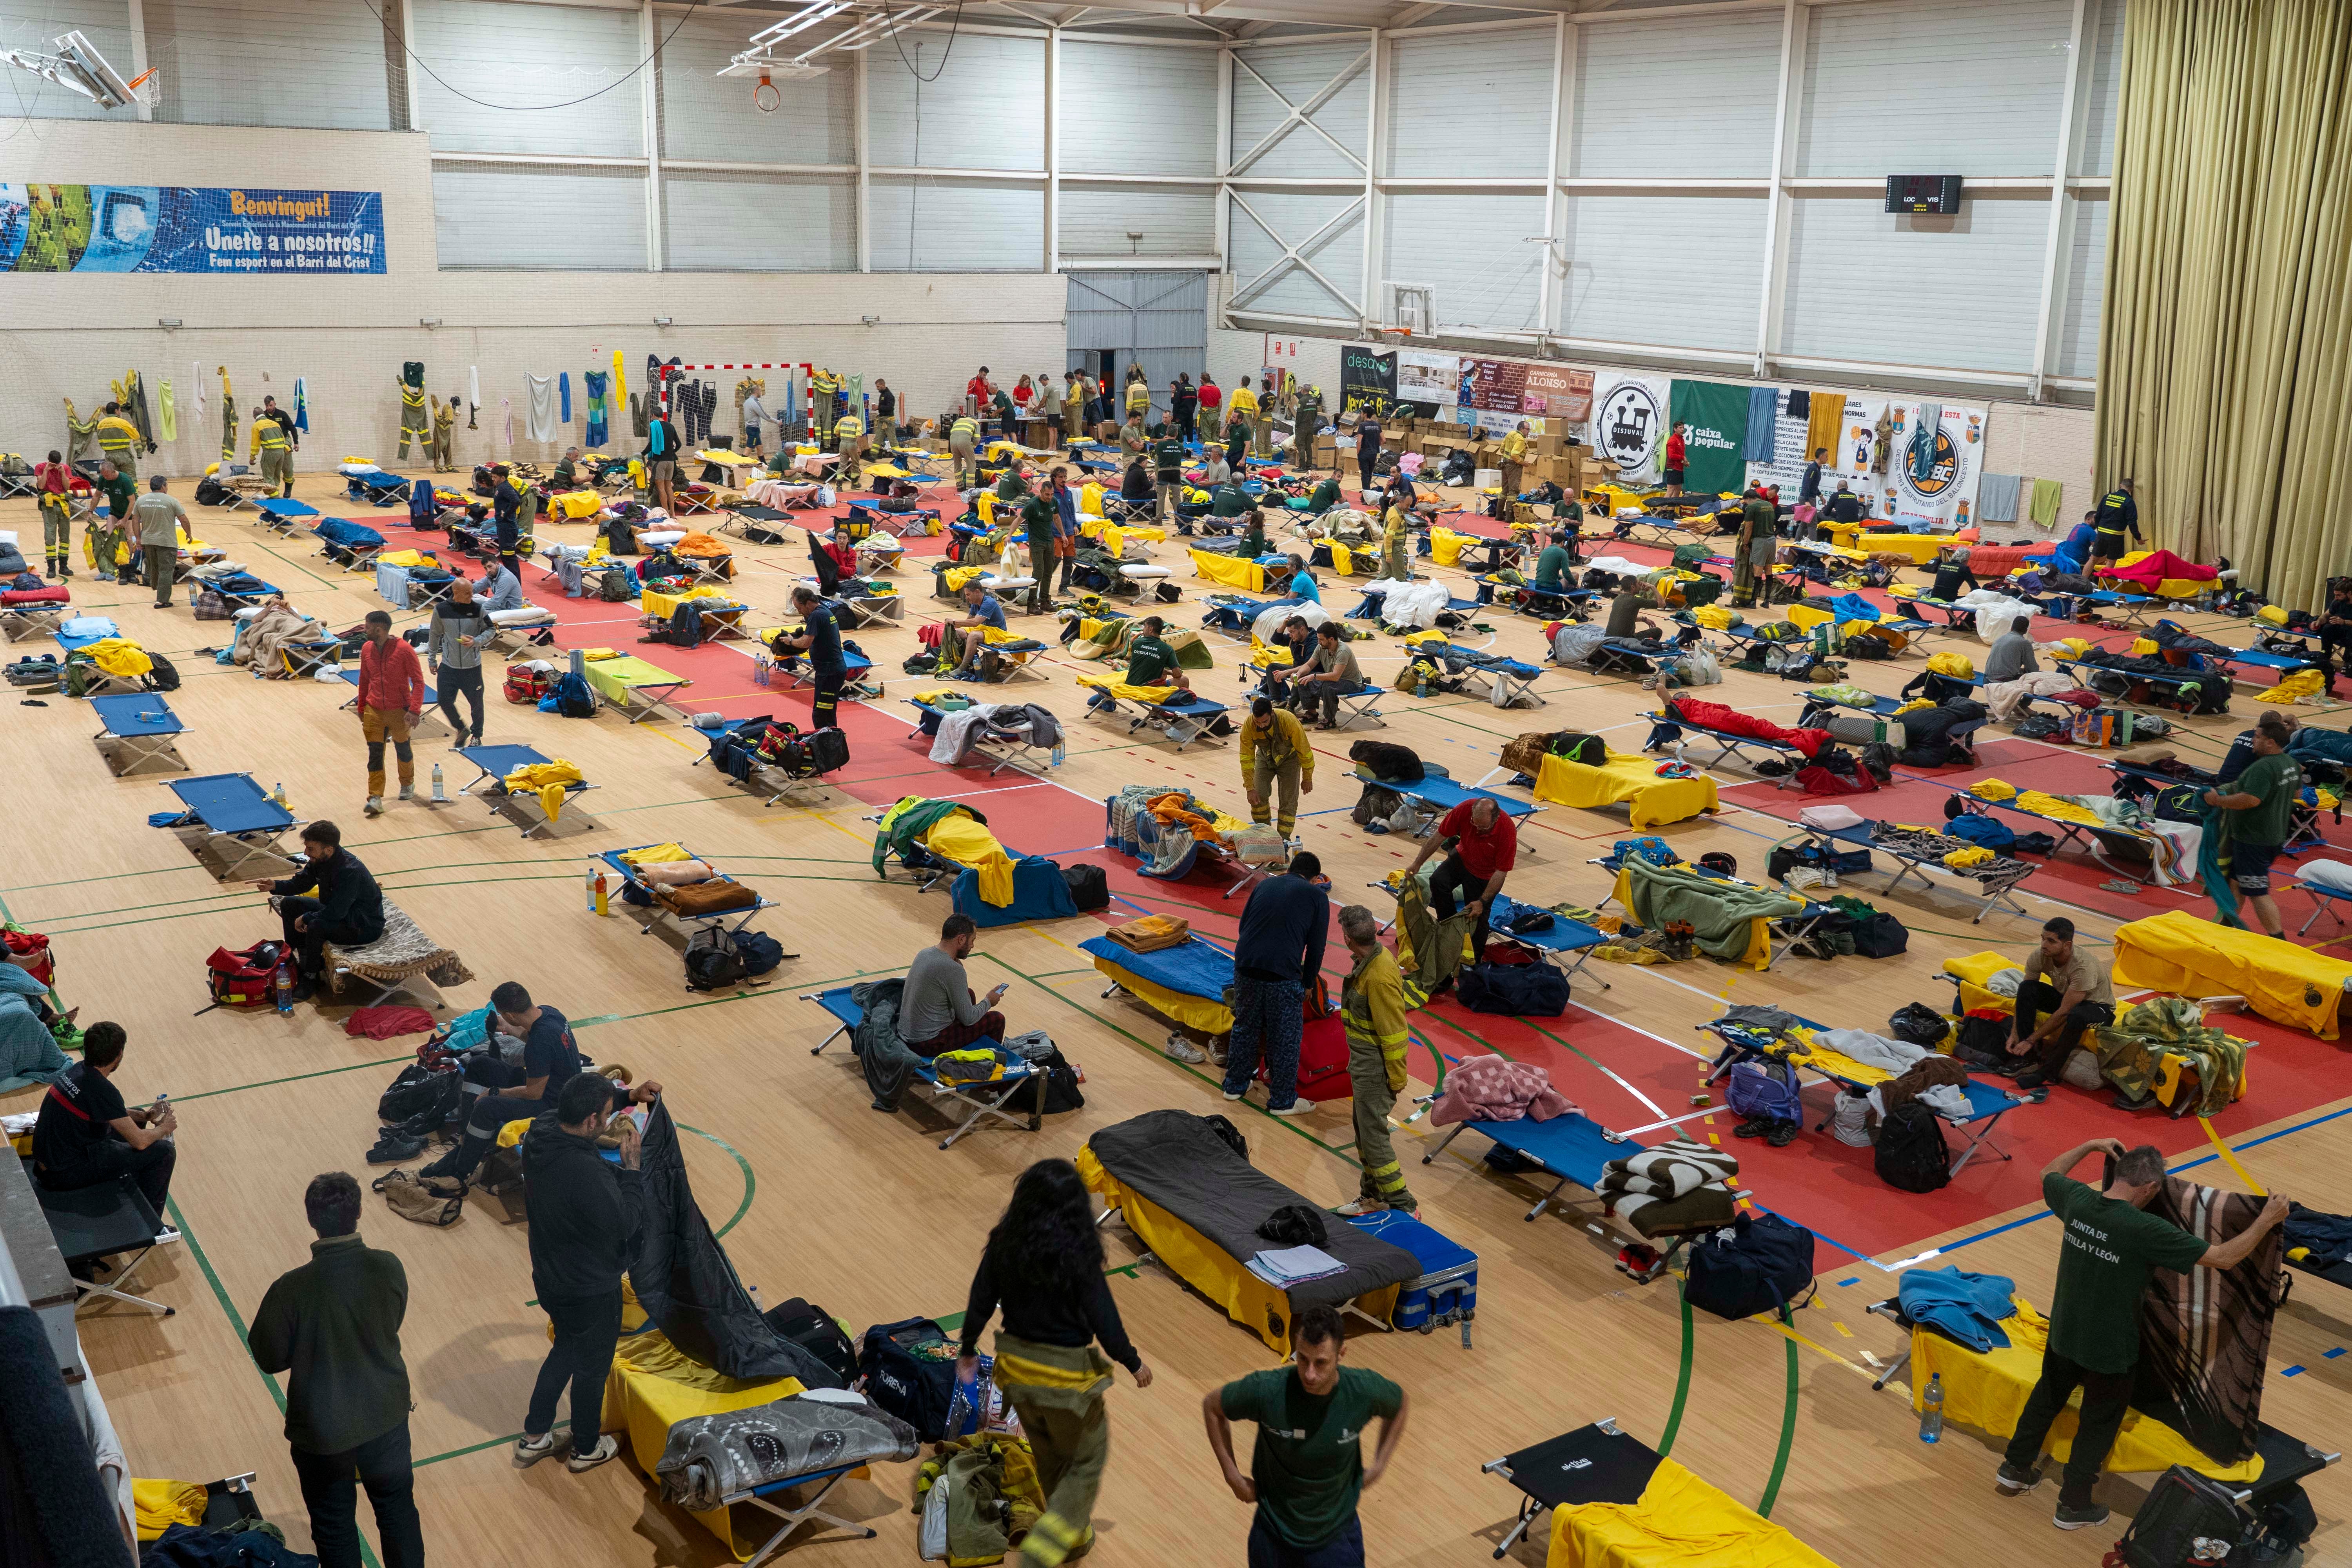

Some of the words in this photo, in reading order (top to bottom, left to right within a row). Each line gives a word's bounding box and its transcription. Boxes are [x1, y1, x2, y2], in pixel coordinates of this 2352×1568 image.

[231, 191, 330, 221] Benvingut!
[205, 223, 262, 251] Únete
[268, 235, 279, 251] a
[284, 232, 375, 254] nosotros!!
[209, 254, 232, 267] Fem
[235, 256, 267, 270] esport
[270, 259, 283, 267] en
[285, 256, 294, 267] el
[297, 254, 323, 268] Barri
[327, 256, 341, 268] del
[344, 254, 370, 268] Crist
[1526, 376, 1566, 388] ALONSO
[1599, 381, 1625, 410] DISTRIBUIDORA
[1625, 380, 1648, 391] JUGUETERA
[1613, 427, 1643, 436] DISJUVAL
[1695, 428, 1721, 439] caixa
[1904, 434, 1912, 446] CLUB
[1938, 424, 1949, 433] ARRIO
[1953, 435, 1962, 453] CRISTO
[1694, 437, 1735, 449] popular
[1857, 451, 1863, 459] 1
[1902, 486, 1935, 508] DISFRUTANDO
[1949, 458, 1968, 498] BALONCESTO
[60, 1073, 80, 1095] Bomberos
[2070, 1219, 2095, 1237] JUNTA
[2096, 1231, 2108, 1241] DE
[2063, 1231, 2086, 1251] STILLA
[2088, 1245, 2095, 1253] Y
[2095, 1247, 2120, 1264] LEÓN
[880, 1369, 906, 1396] FORESA
[1561, 1458, 1589, 1470] aktive
